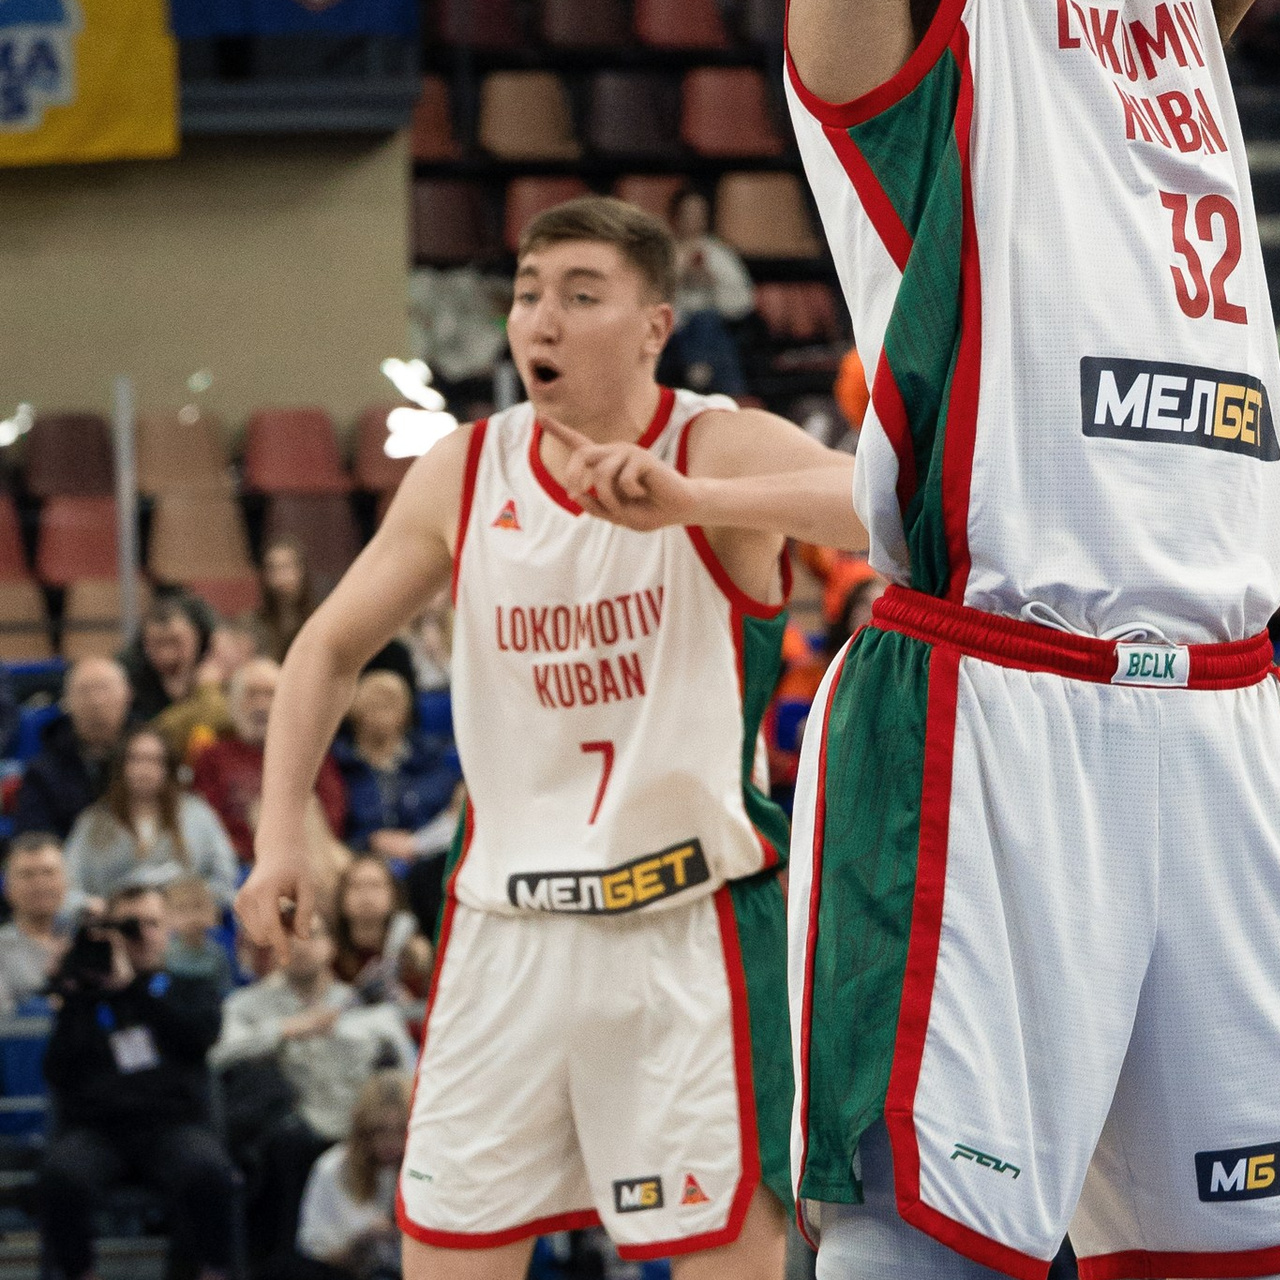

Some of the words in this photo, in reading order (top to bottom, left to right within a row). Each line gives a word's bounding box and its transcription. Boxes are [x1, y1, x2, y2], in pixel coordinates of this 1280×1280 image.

[1159, 190, 1248, 325] 32
[494, 585, 665, 652] LOKOMOTIV
[532, 652, 646, 709] KUBAN
[1126, 652, 1176, 679] BCLK
[581, 740, 616, 825] 7
